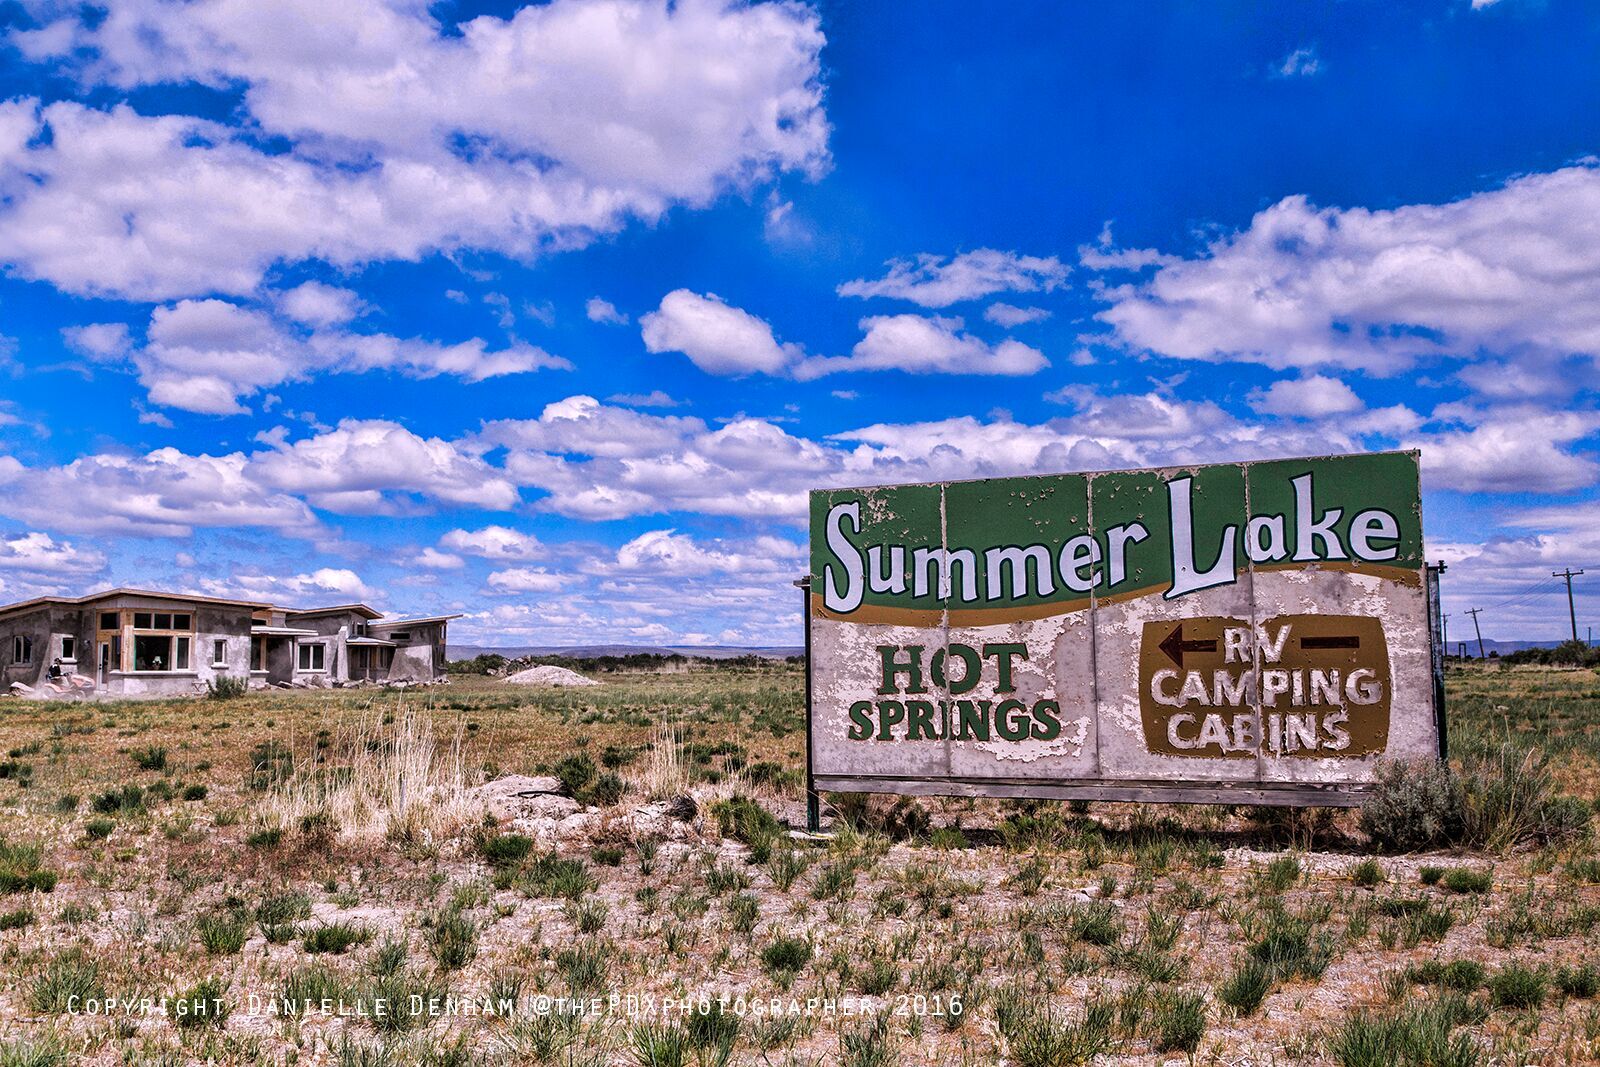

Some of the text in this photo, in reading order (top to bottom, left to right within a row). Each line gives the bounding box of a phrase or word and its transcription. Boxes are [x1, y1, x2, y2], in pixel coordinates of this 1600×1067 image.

[823, 471, 1402, 614] Summer Lake
[1223, 624, 1293, 664] RV
[877, 642, 1029, 695] HOT
[1150, 667, 1383, 707] CAMPING
[847, 700, 1061, 741] SPRINGS
[1165, 711, 1352, 752] CABINS
